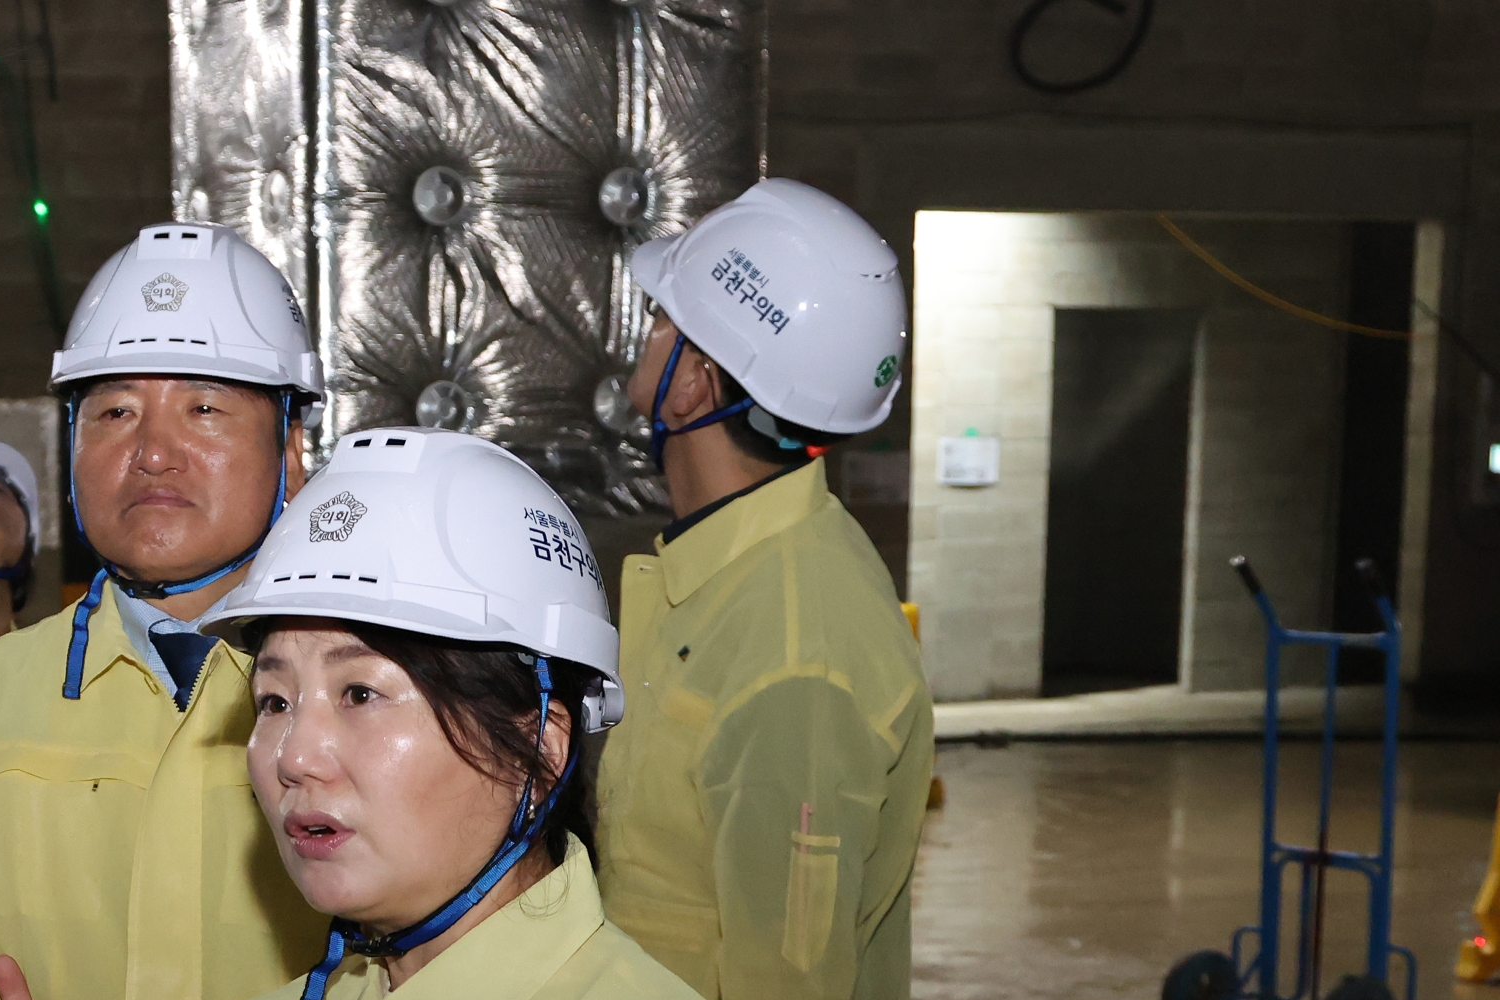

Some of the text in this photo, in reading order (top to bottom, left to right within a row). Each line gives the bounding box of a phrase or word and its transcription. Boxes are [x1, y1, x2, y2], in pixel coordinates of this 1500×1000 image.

[728, 247, 770, 288] 서울특별시
[152, 288, 175, 298] 의회
[711, 258, 790, 335] 금천구의회
[320, 511, 349, 524] 의회
[524, 507, 581, 544] 서울특별시
[529, 527, 604, 591] 금천구의
